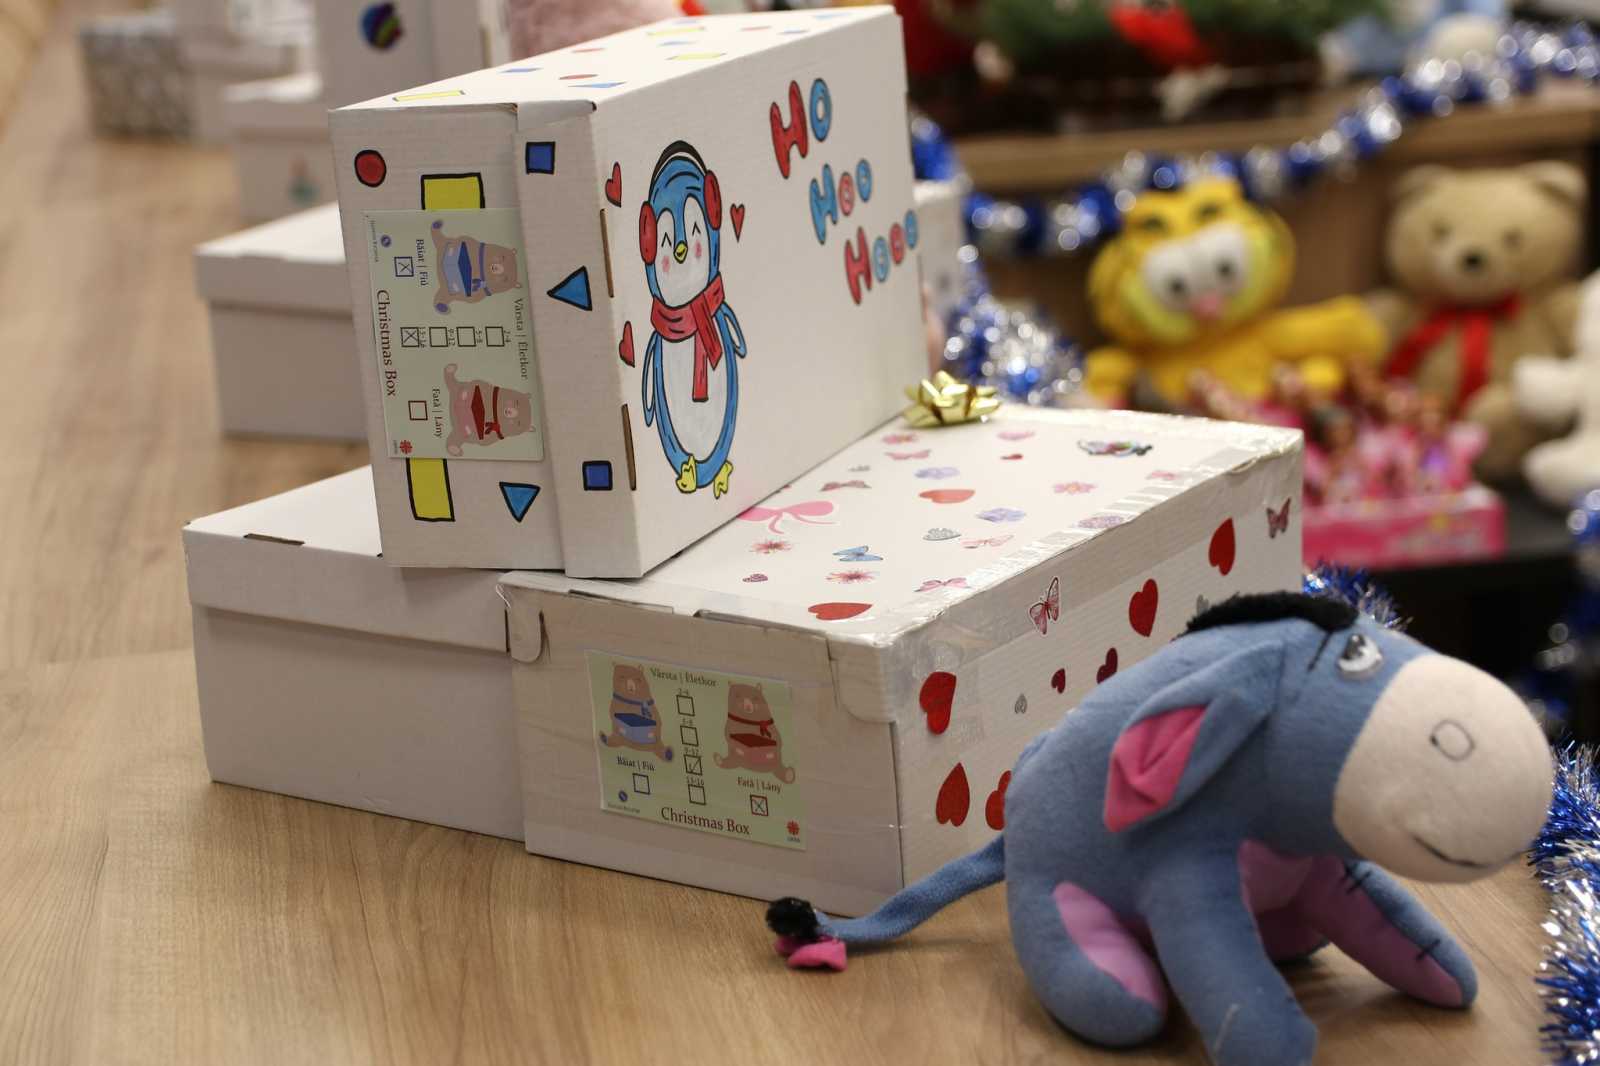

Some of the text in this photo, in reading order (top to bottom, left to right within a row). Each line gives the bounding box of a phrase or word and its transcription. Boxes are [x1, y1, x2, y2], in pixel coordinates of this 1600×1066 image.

[376, 289, 397, 397] Christmas Box
[434, 416, 443, 439] Lány
[762, 781, 783, 795] Lány
[661, 806, 725, 831] Christmas
[727, 818, 751, 835] Box
